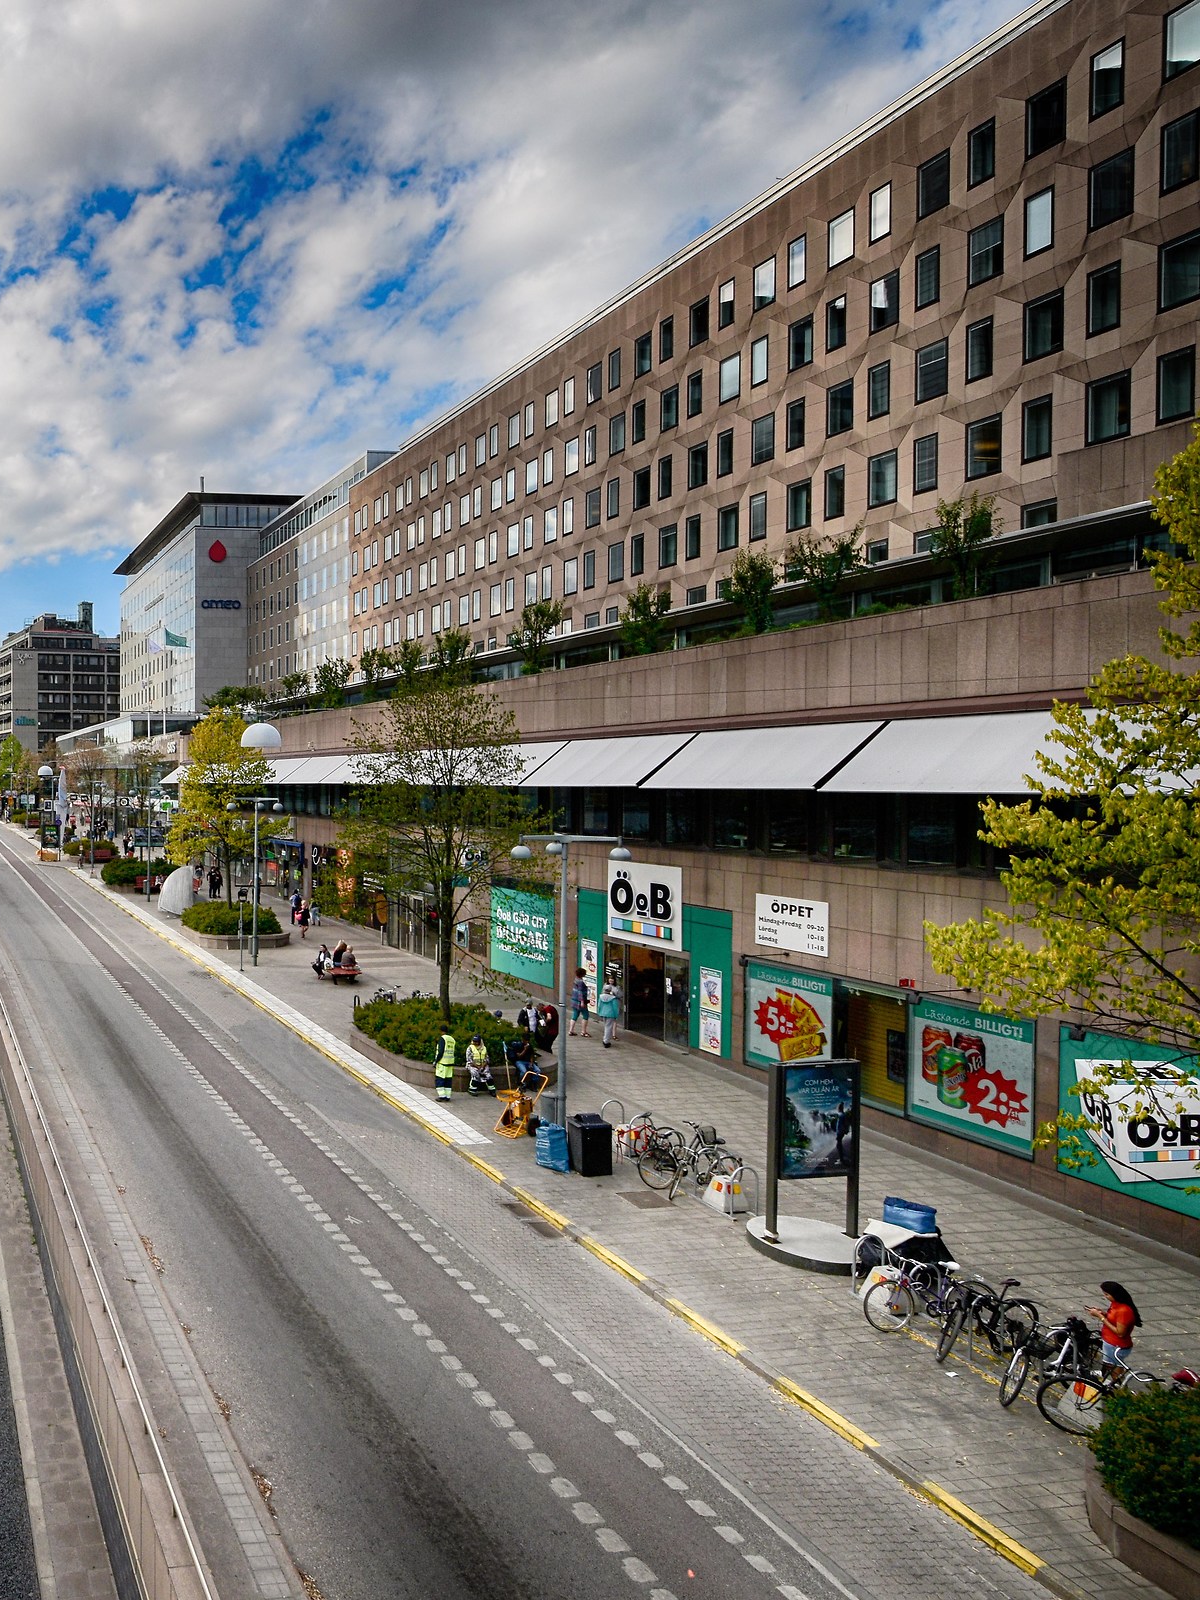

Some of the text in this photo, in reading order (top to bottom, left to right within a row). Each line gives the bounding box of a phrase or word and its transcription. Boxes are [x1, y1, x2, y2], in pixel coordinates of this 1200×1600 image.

[610, 870, 672, 920] ÖoB
[771, 899, 814, 918] ÖPPET
[758, 916, 824, 932] Måndag-Fredag 09-20
[758, 925, 824, 942] Lördag 10-18
[758, 934, 824, 951] Söndag 11-18
[791, 977, 826, 993] BILLIGT!
[924, 1008, 1023, 1039] Läskande BILLIGT!
